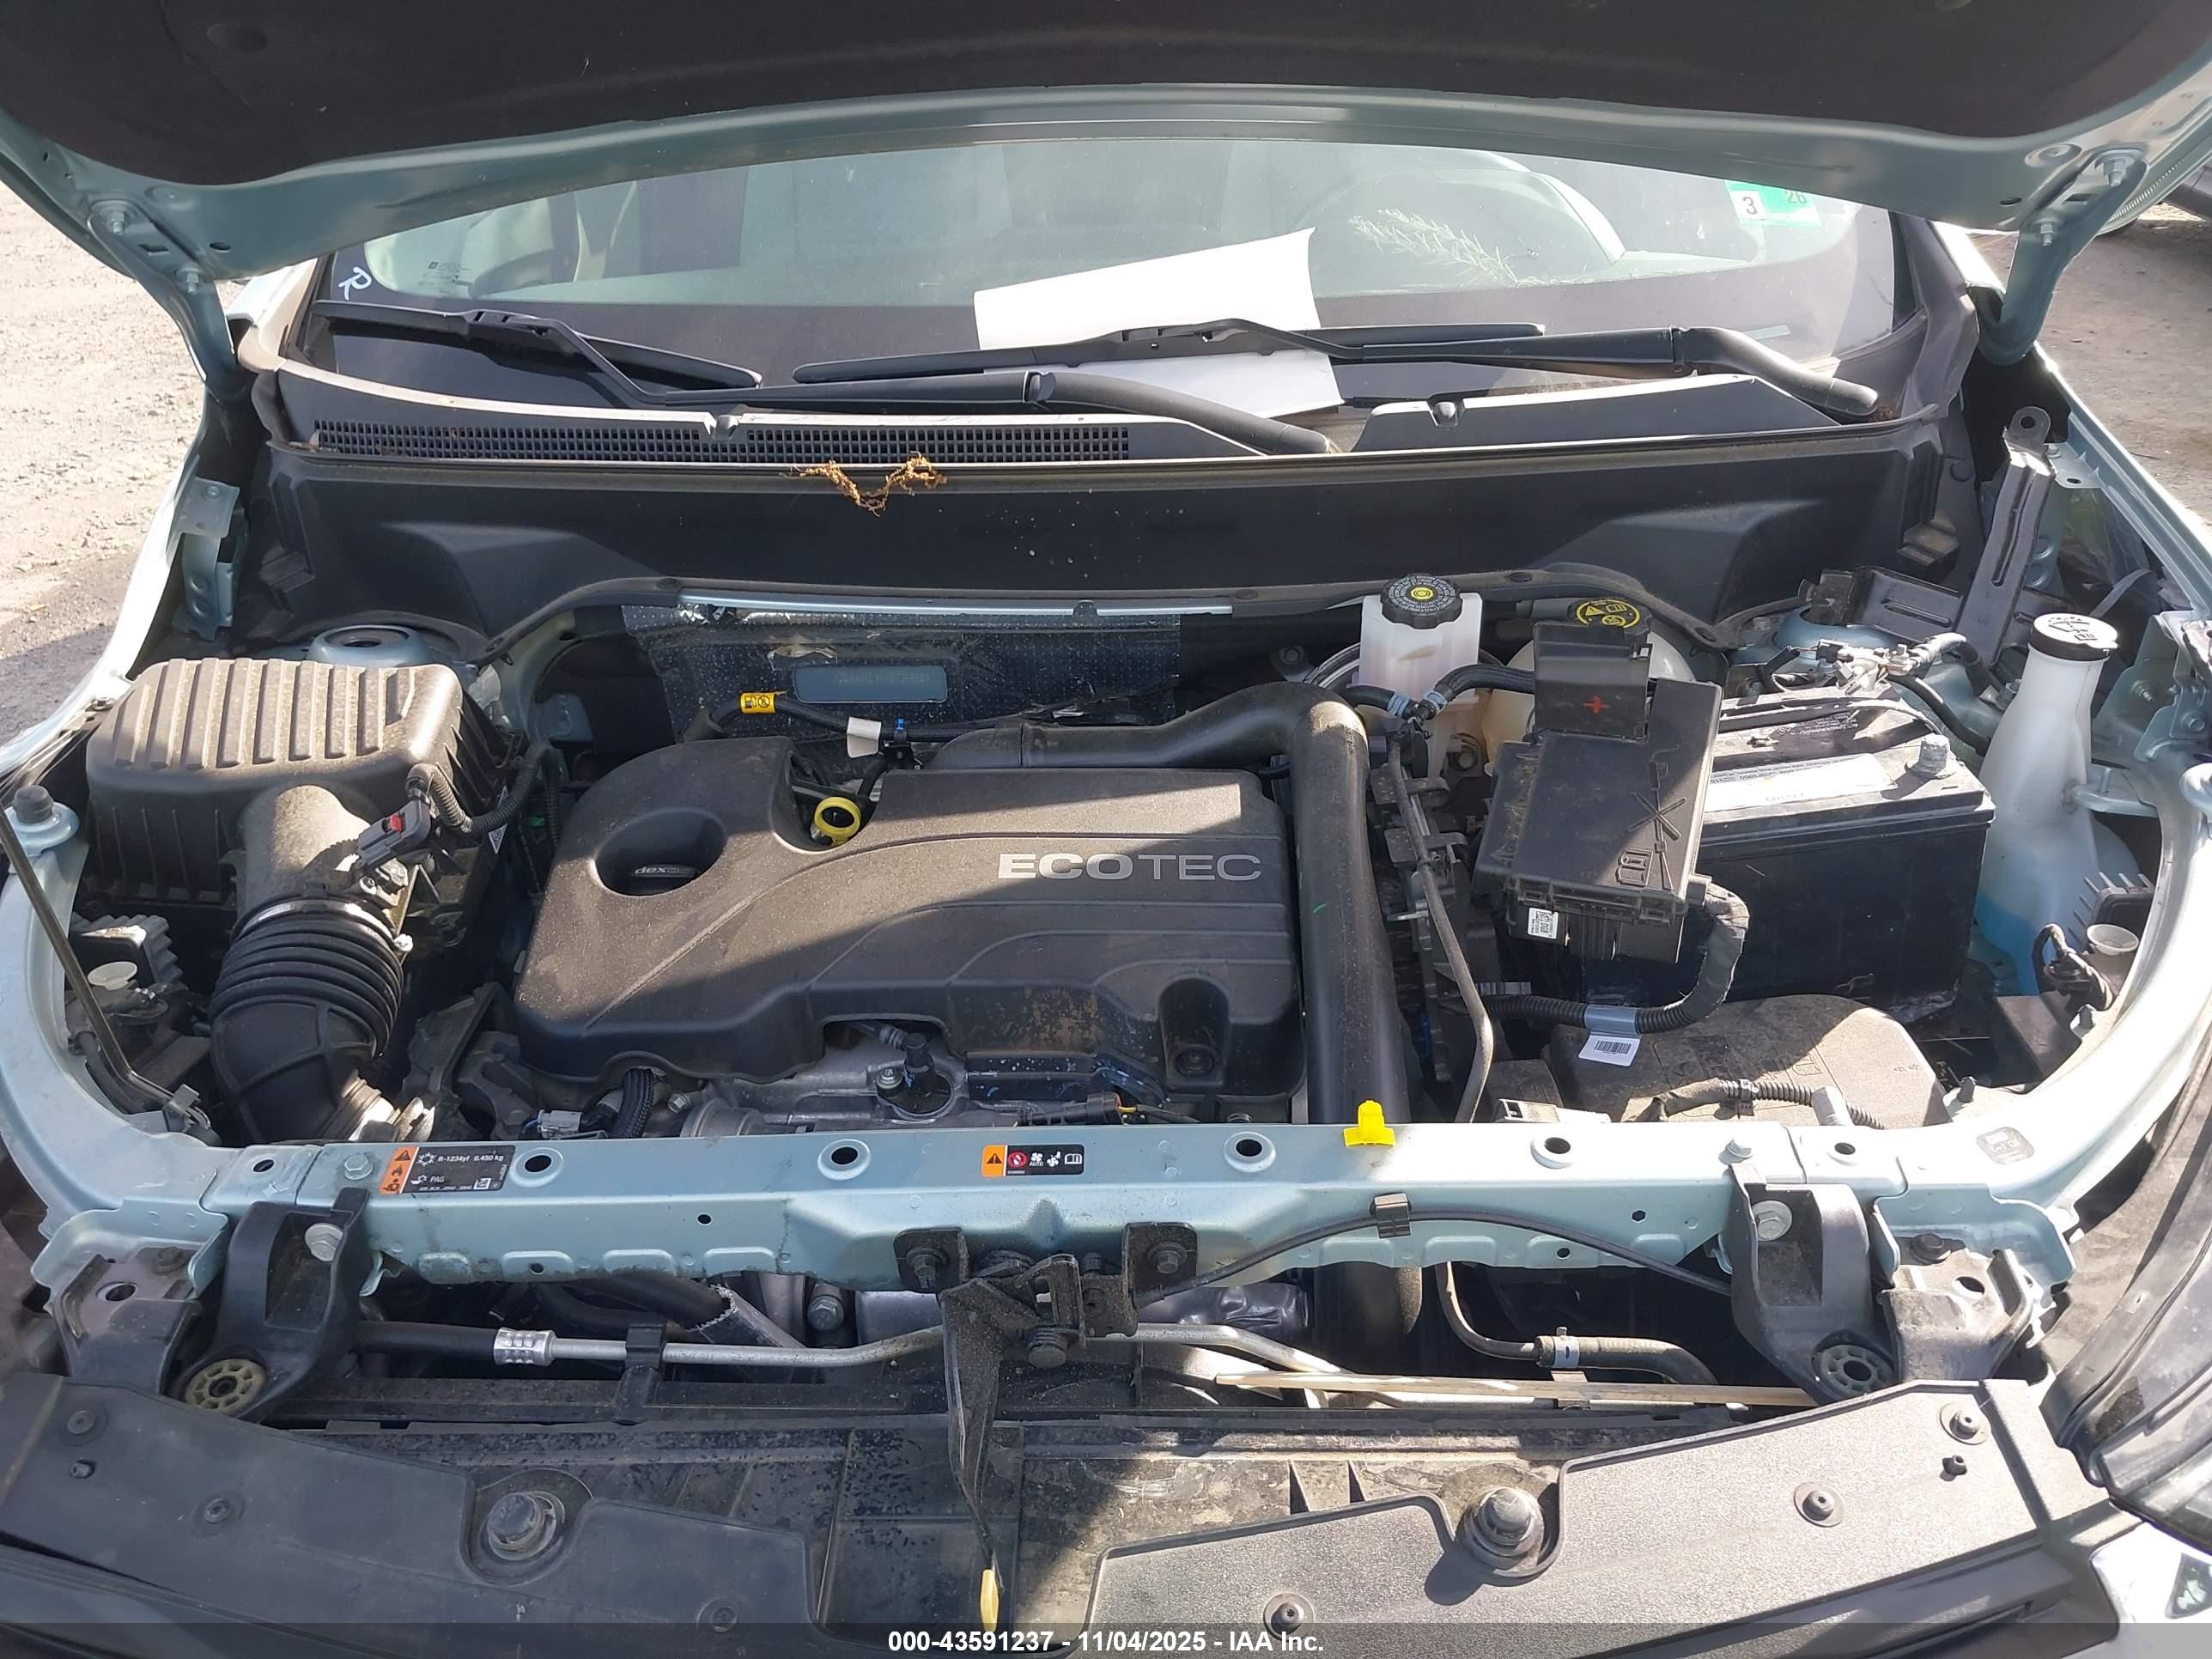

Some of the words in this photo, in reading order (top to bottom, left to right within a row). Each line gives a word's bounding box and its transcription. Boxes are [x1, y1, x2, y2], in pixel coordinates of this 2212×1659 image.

[1742, 197, 1758, 215] 3
[338, 266, 372, 301] R
[998, 854, 1262, 881] ECOTEC
